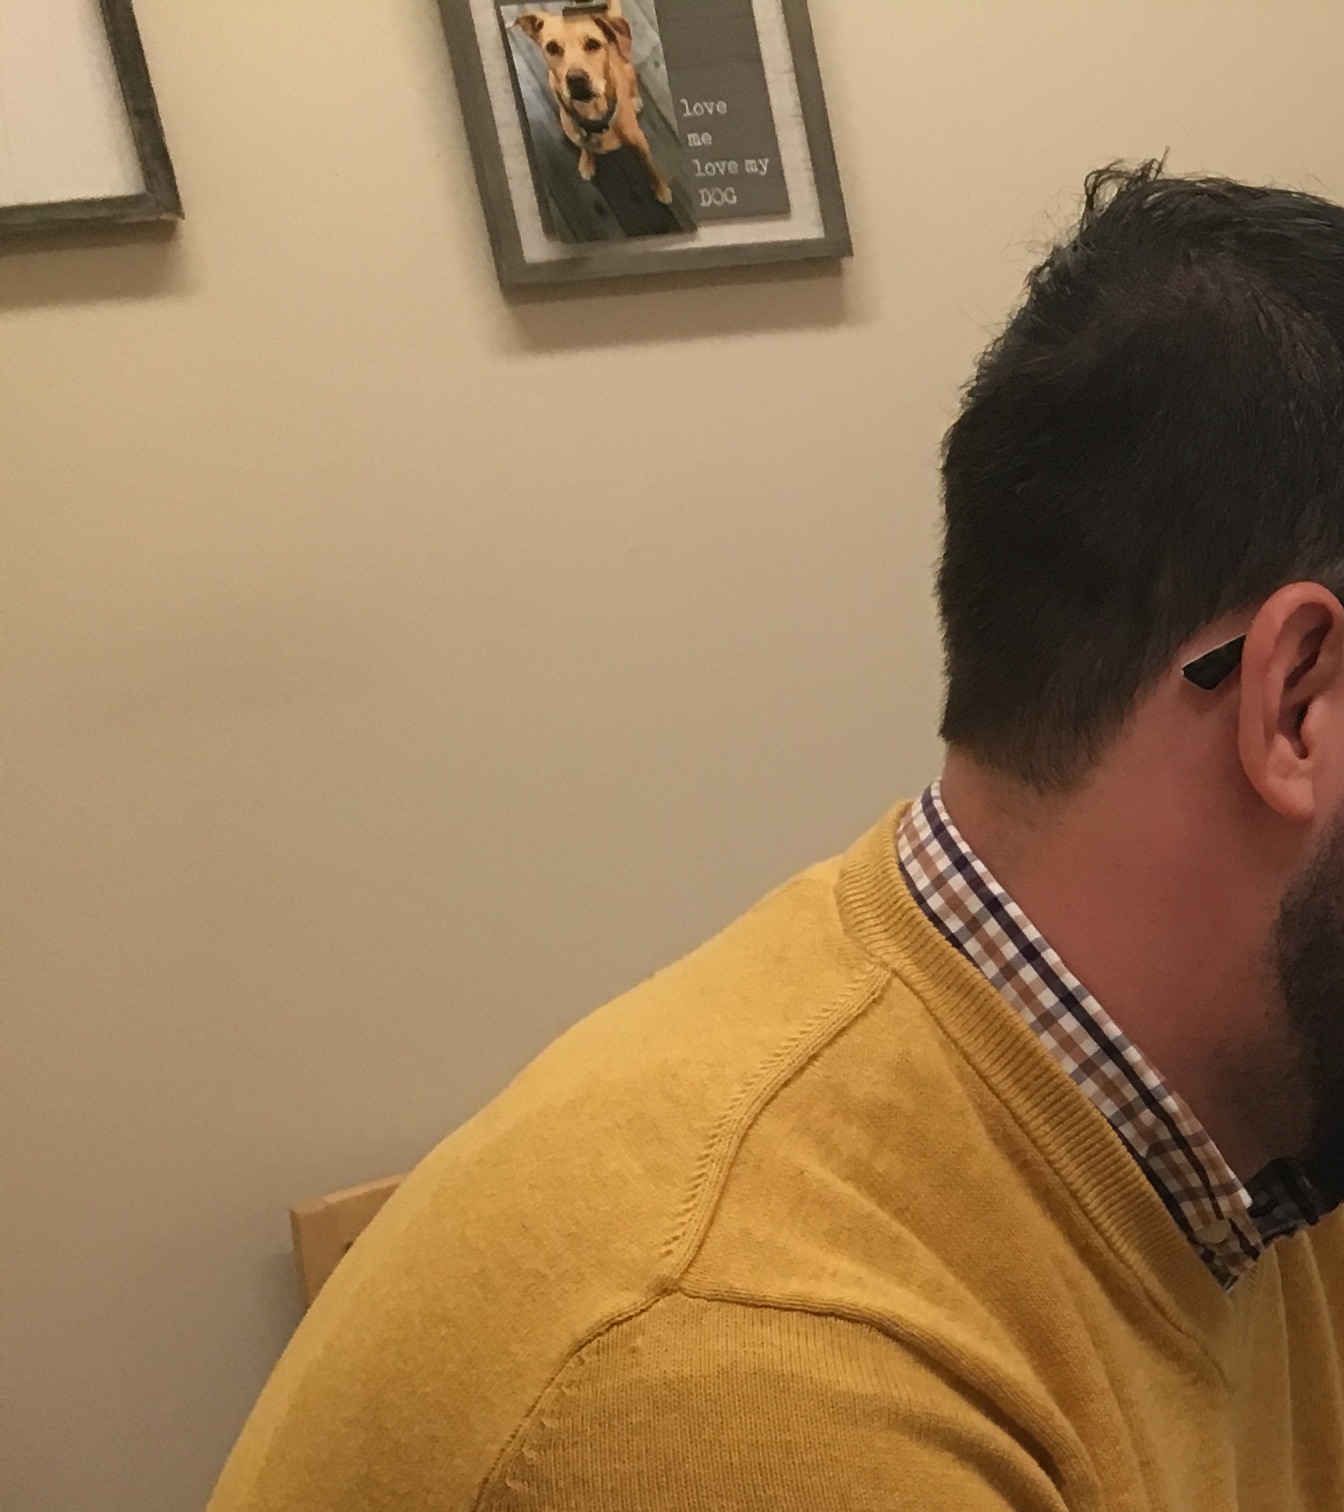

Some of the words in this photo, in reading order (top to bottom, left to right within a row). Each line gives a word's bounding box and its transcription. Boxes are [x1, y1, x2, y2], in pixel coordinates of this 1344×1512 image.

[680, 98, 728, 117] love
[687, 132, 712, 147] me
[692, 158, 739, 177] love
[744, 157, 770, 176] my
[699, 186, 738, 207] DOG
